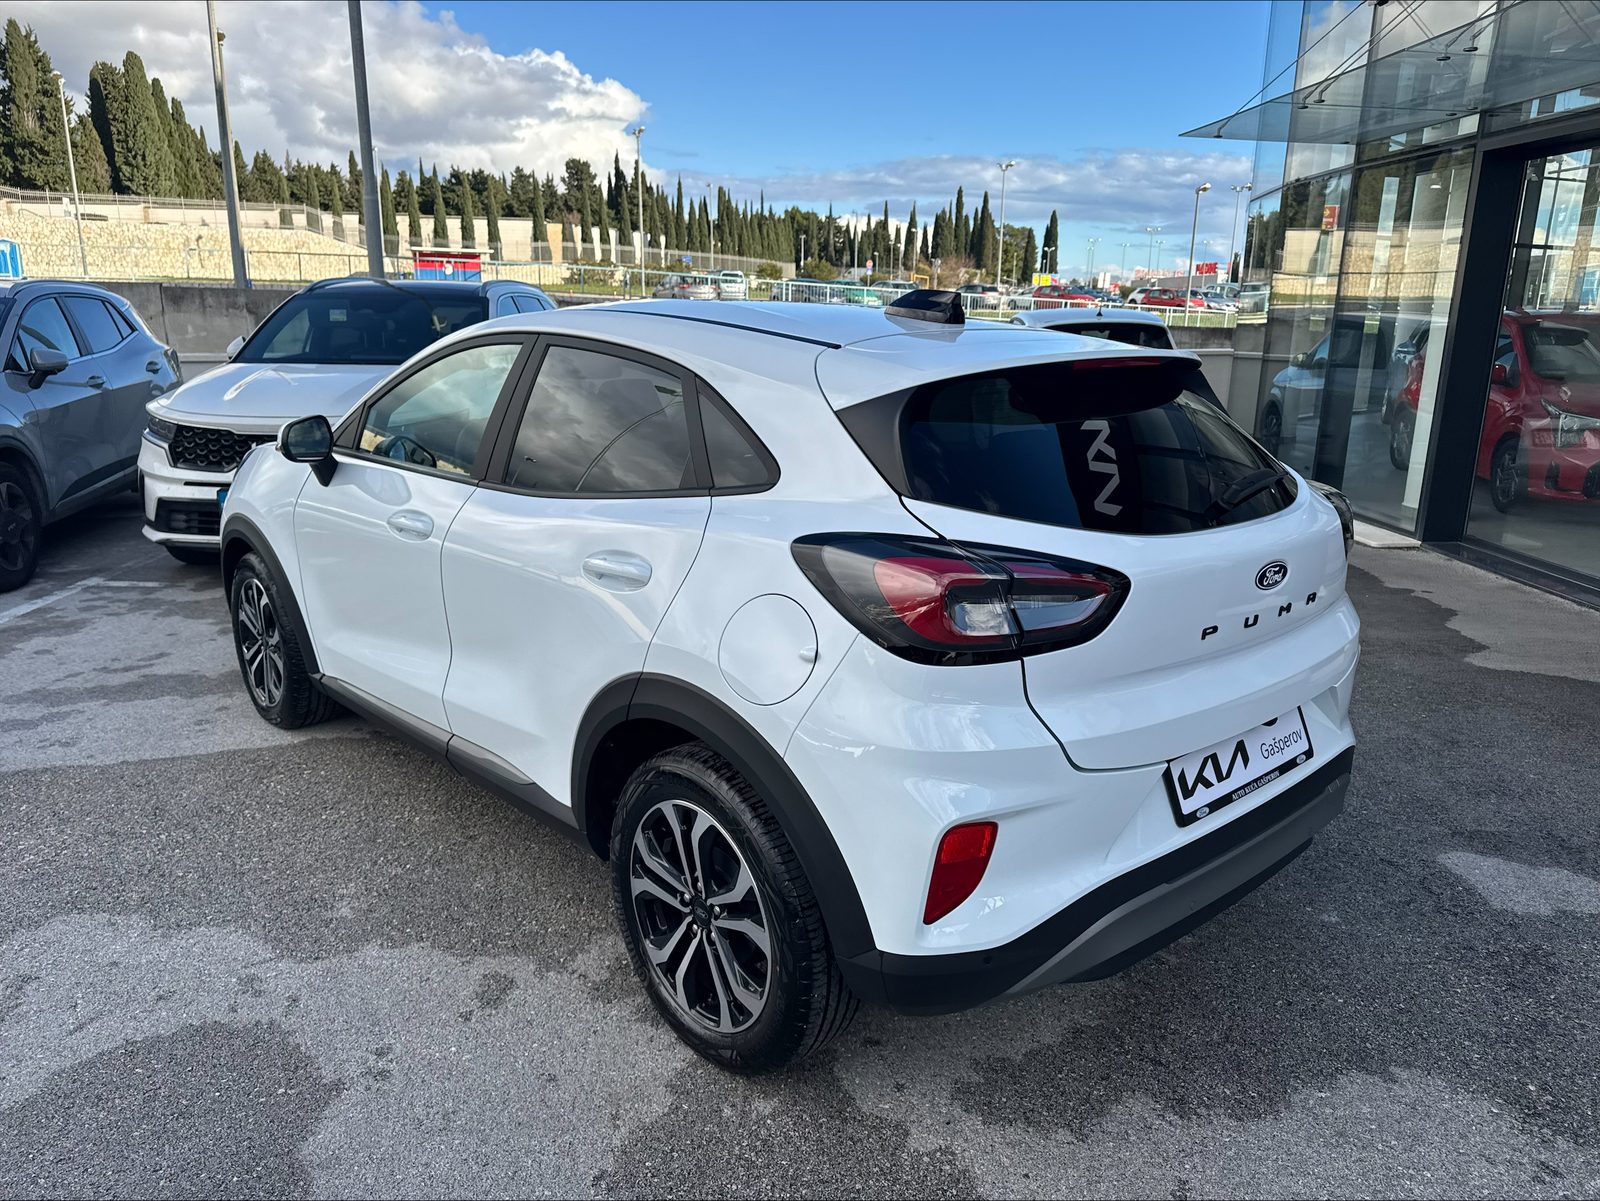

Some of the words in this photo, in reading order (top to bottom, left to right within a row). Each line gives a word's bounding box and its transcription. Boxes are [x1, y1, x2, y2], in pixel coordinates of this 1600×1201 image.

[1201, 592, 1317, 640] PUMA
[1178, 739, 1249, 800] KIA
[1260, 729, 1302, 759] Gašperov
[1232, 789, 1245, 801] AUTO
